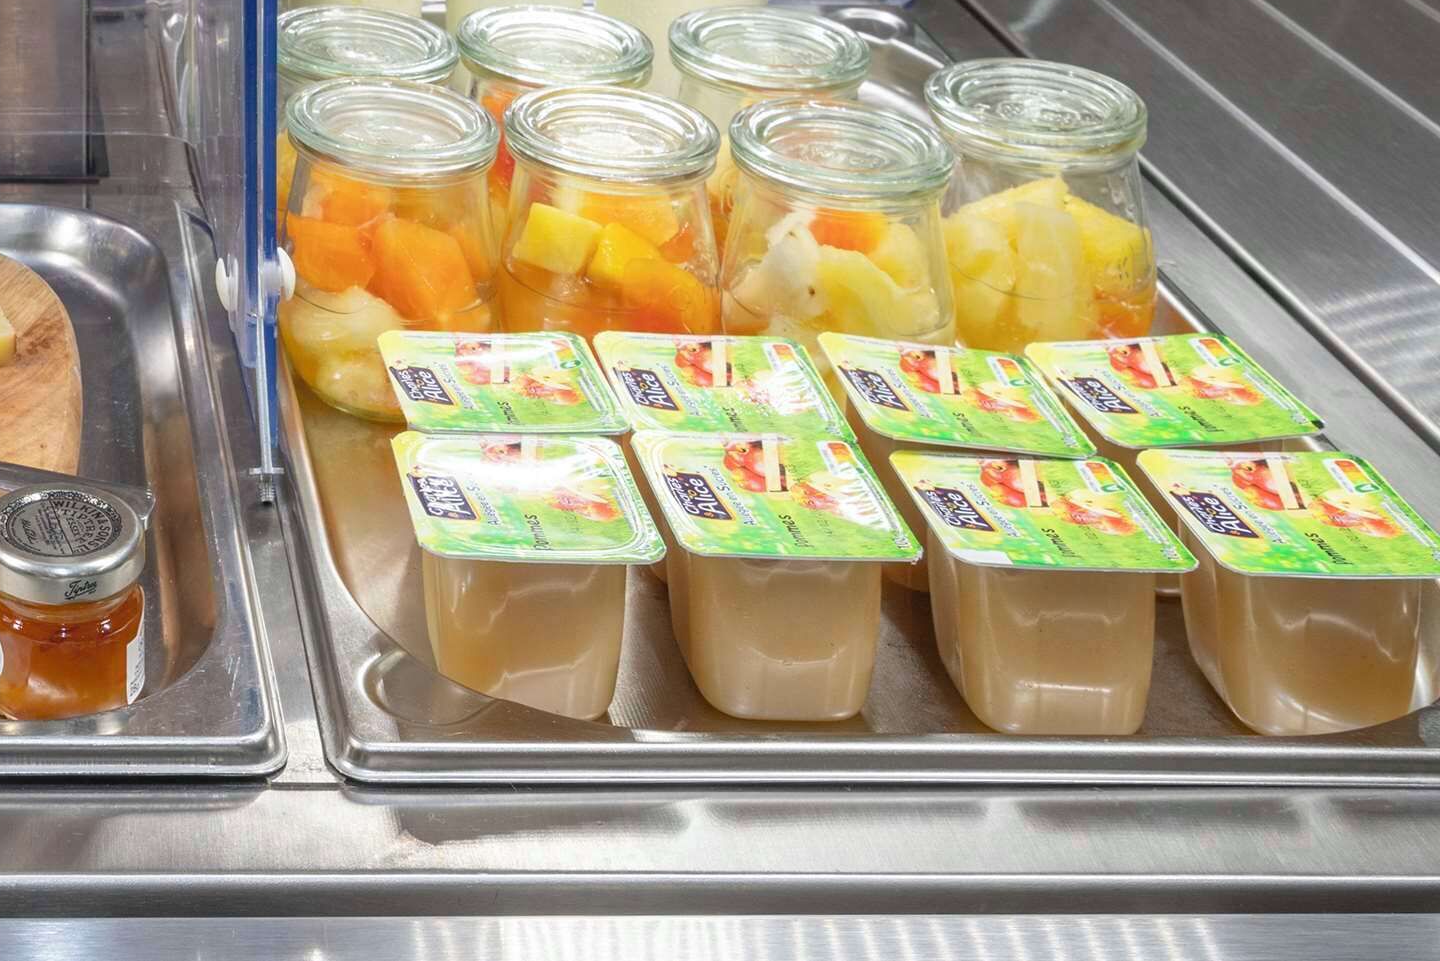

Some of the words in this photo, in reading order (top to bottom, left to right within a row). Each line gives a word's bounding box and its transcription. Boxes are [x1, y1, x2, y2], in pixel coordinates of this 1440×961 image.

[419, 370, 451, 403] Alice
[647, 373, 674, 407] Alice
[868, 373, 903, 408] Alice
[1088, 380, 1124, 411] Alice
[53, 499, 105, 520] WILKIN
[667, 476, 700, 515] Charles
[690, 477, 727, 515] Alice
[925, 491, 960, 527] Charles
[948, 492, 984, 527] Alice
[1182, 496, 1225, 534] Charles
[1205, 496, 1251, 535] Alice
[1304, 531, 1355, 566] Pommes
[64, 579, 98, 601] Tiptree
